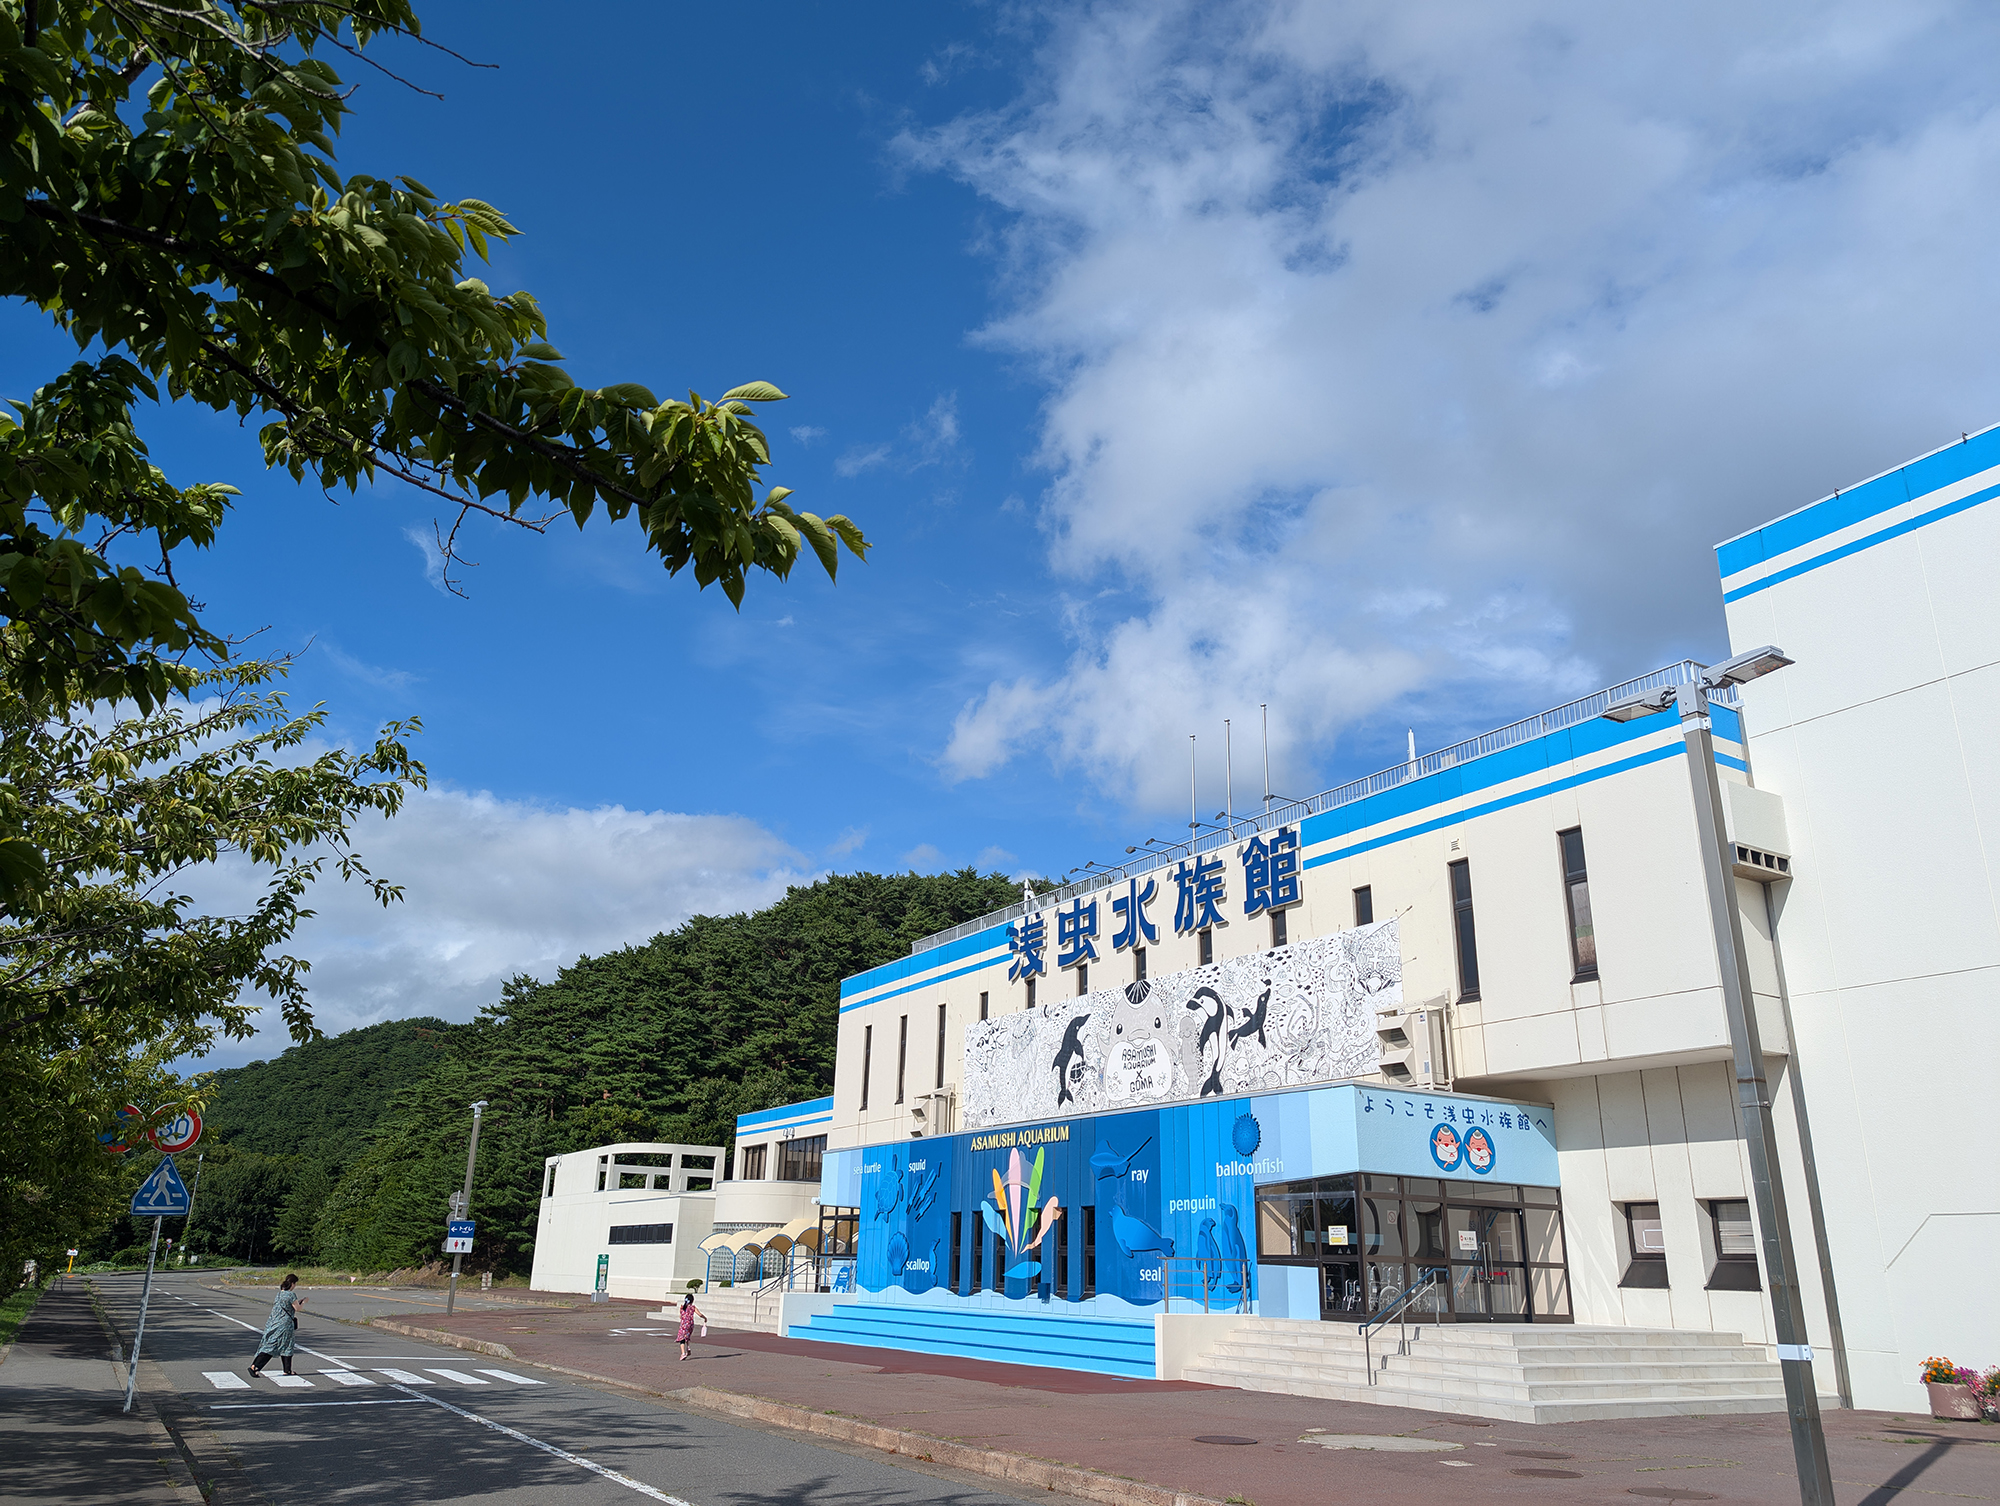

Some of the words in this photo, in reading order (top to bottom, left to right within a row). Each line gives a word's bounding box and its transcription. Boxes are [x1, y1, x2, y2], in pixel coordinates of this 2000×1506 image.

[1007, 827, 1302, 981] 浅虫水族館
[1122, 1044, 1156, 1060] ASAMUSHI
[1123, 1058, 1156, 1070] AQUARIUM
[1130, 1076, 1153, 1092] GOMA
[1364, 1096, 1548, 1131] ようこそ浅虫水族館へ
[970, 1132, 1017, 1152] ASAMUSHI
[1018, 1126, 1069, 1148] AQUARIUM
[853, 1164, 863, 1175] sea
[864, 1162, 882, 1174] turtle
[908, 1159, 926, 1174] squid
[1215, 1157, 1284, 1178] balloonfish
[1131, 1168, 1149, 1184] ray
[1169, 1194, 1216, 1215] penguin
[905, 1258, 931, 1273] scallop
[1139, 1267, 1162, 1282] seal
